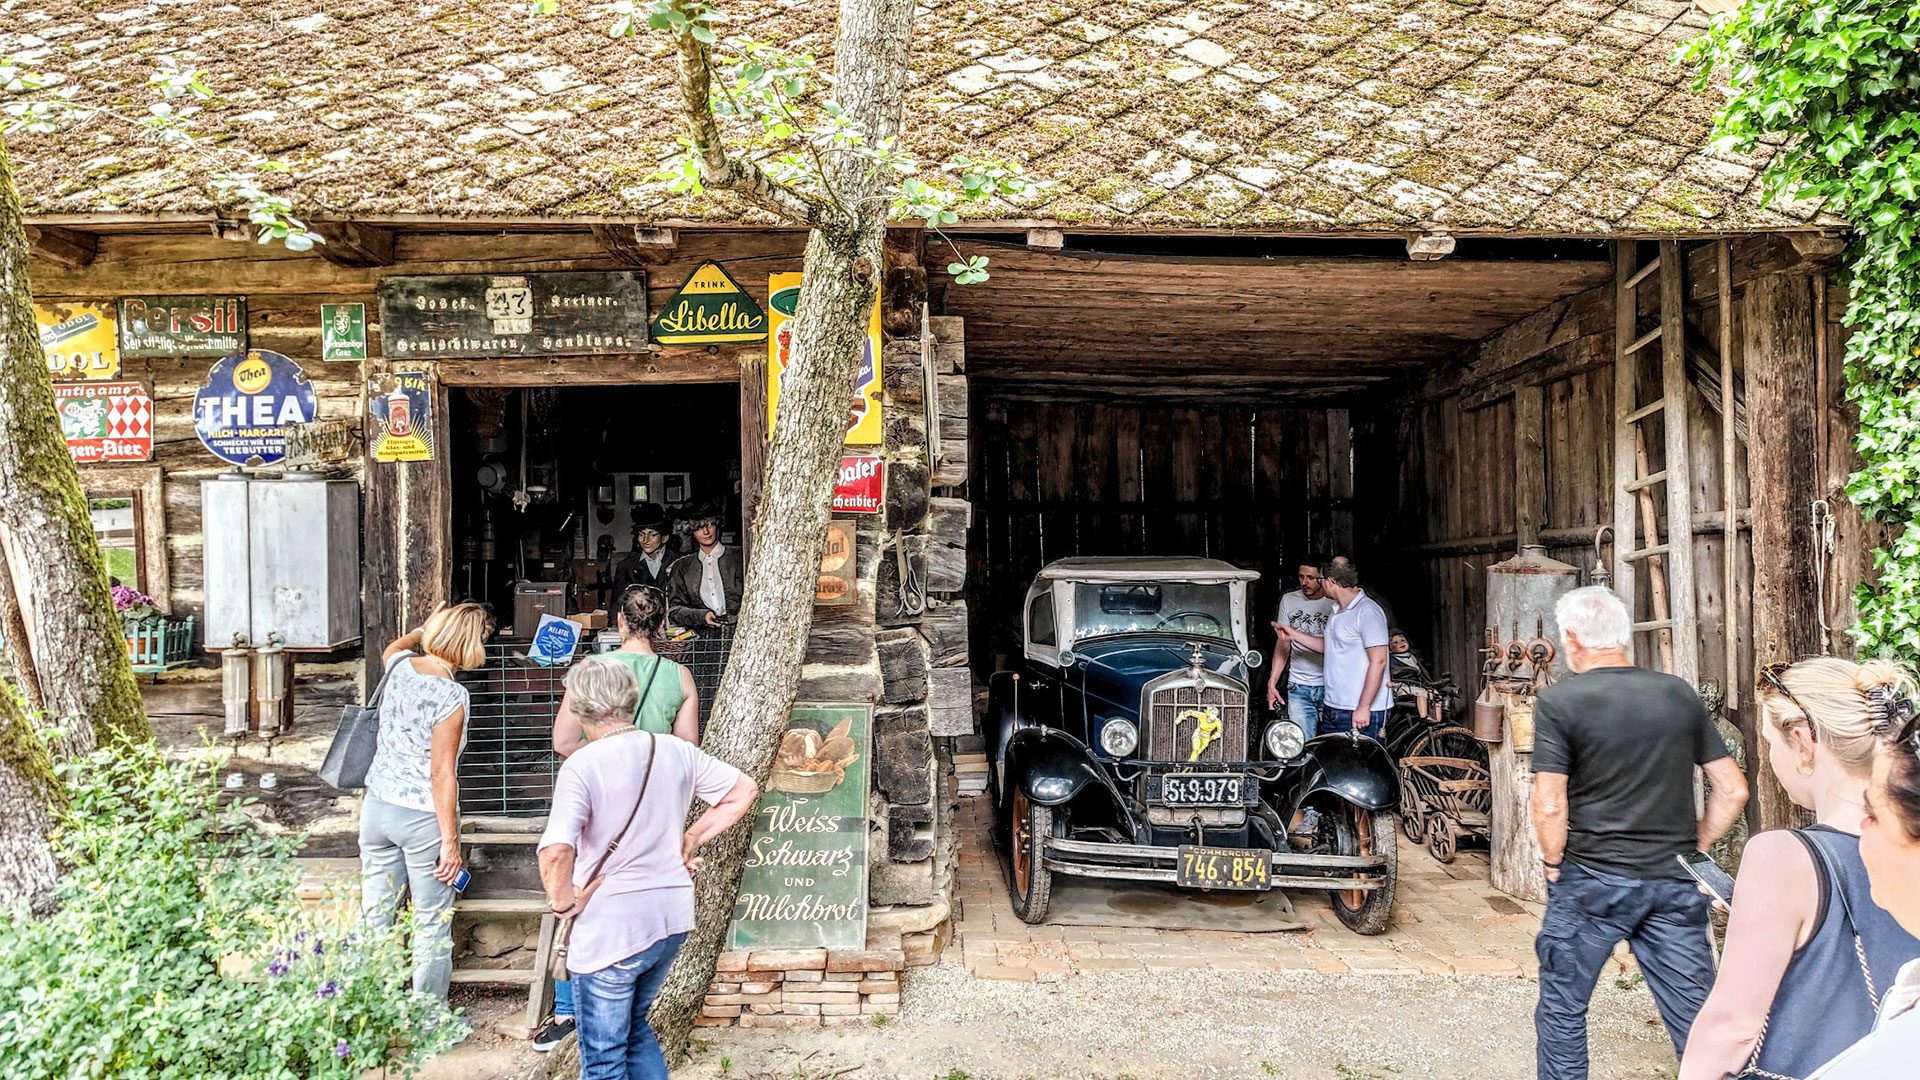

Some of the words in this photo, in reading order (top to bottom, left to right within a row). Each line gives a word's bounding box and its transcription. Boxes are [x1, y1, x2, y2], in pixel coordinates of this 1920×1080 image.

[693, 280, 726, 289] TRINK
[57, 313, 90, 331] ODOL
[123, 297, 238, 334] Persil
[659, 299, 763, 333] Libella
[46, 351, 110, 372] DOL
[238, 366, 267, 383] Thea
[198, 394, 306, 428] THEA
[223, 446, 283, 455] TEEBUTTER
[833, 493, 877, 509] chenbier
[762, 797, 842, 834] Weiss
[745, 836, 854, 878] Schwarz
[1193, 847, 1257, 858] COMMERCIAL
[784, 876, 815, 887] UND
[739, 892, 859, 922] Milchbrot
